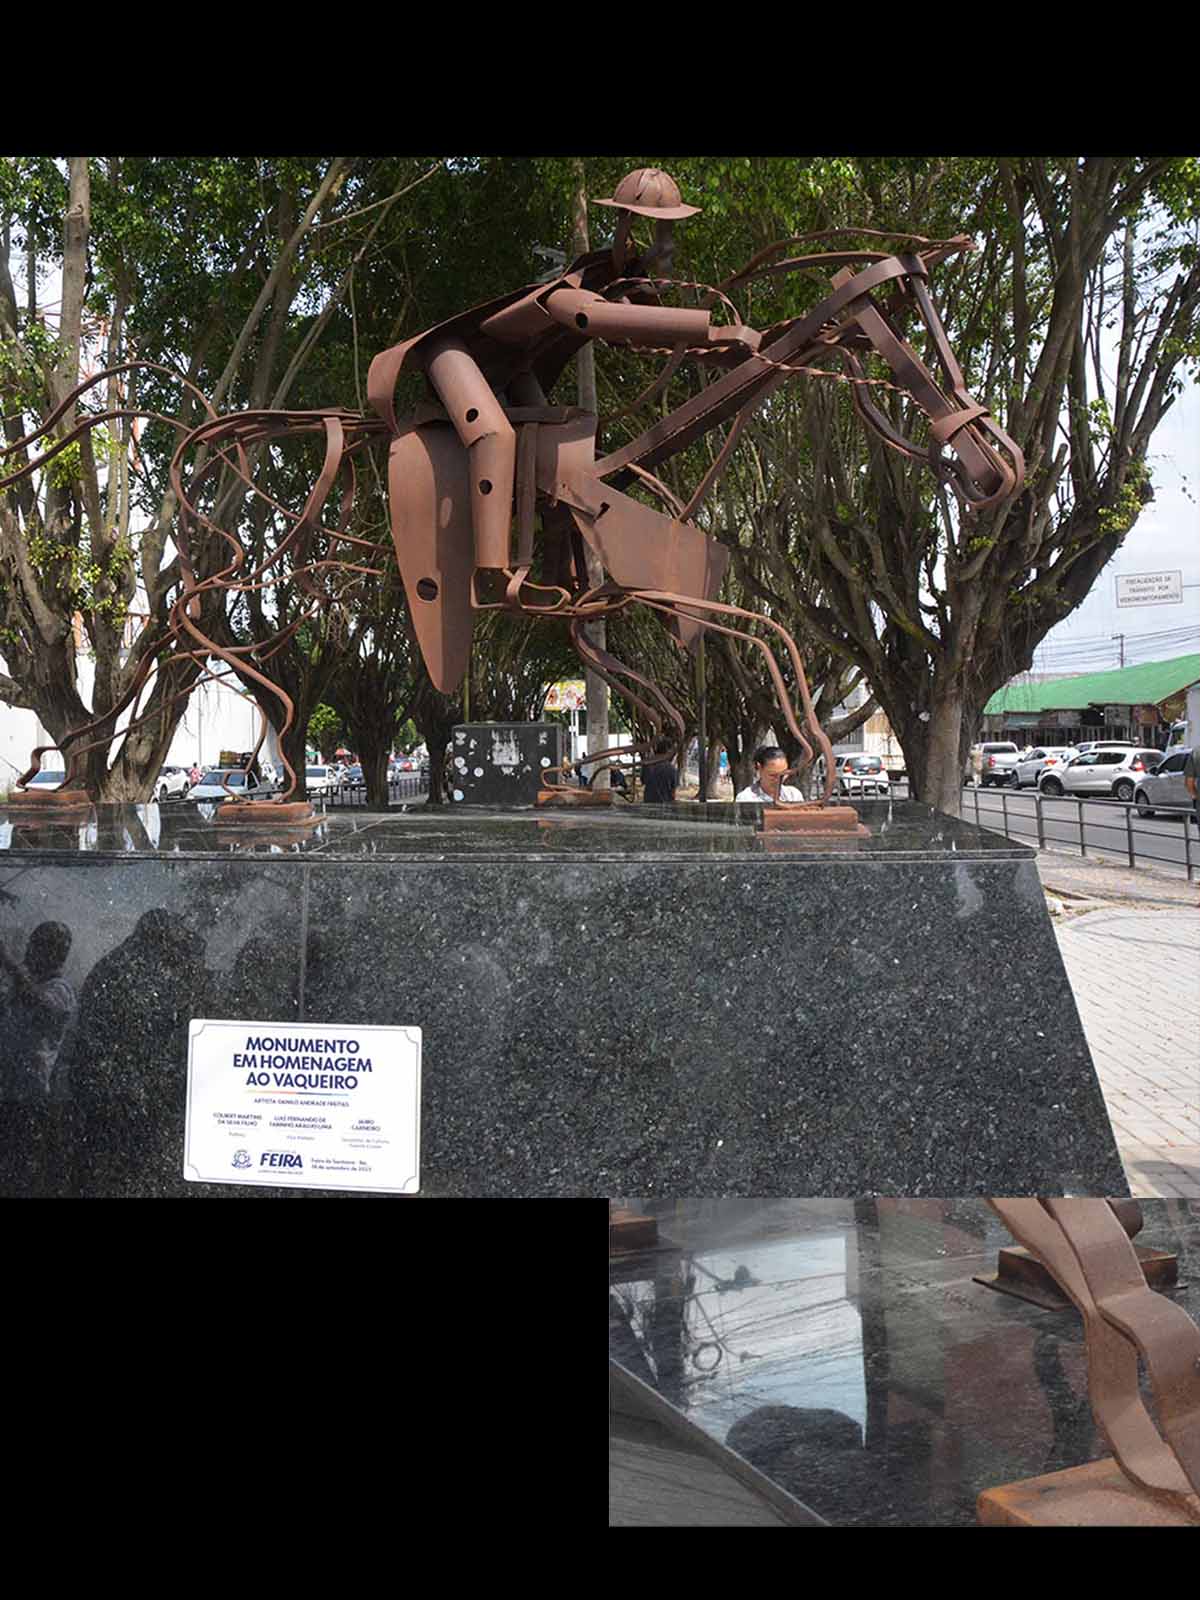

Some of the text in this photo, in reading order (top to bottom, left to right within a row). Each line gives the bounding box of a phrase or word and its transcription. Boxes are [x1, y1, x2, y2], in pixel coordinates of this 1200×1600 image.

[246, 1037, 360, 1054] MONUMENTO
[233, 1054, 373, 1072] EM HOMENAGEM
[246, 1071, 358, 1089] AO VAQUEIRO
[260, 1152, 303, 1168] FEIRA
